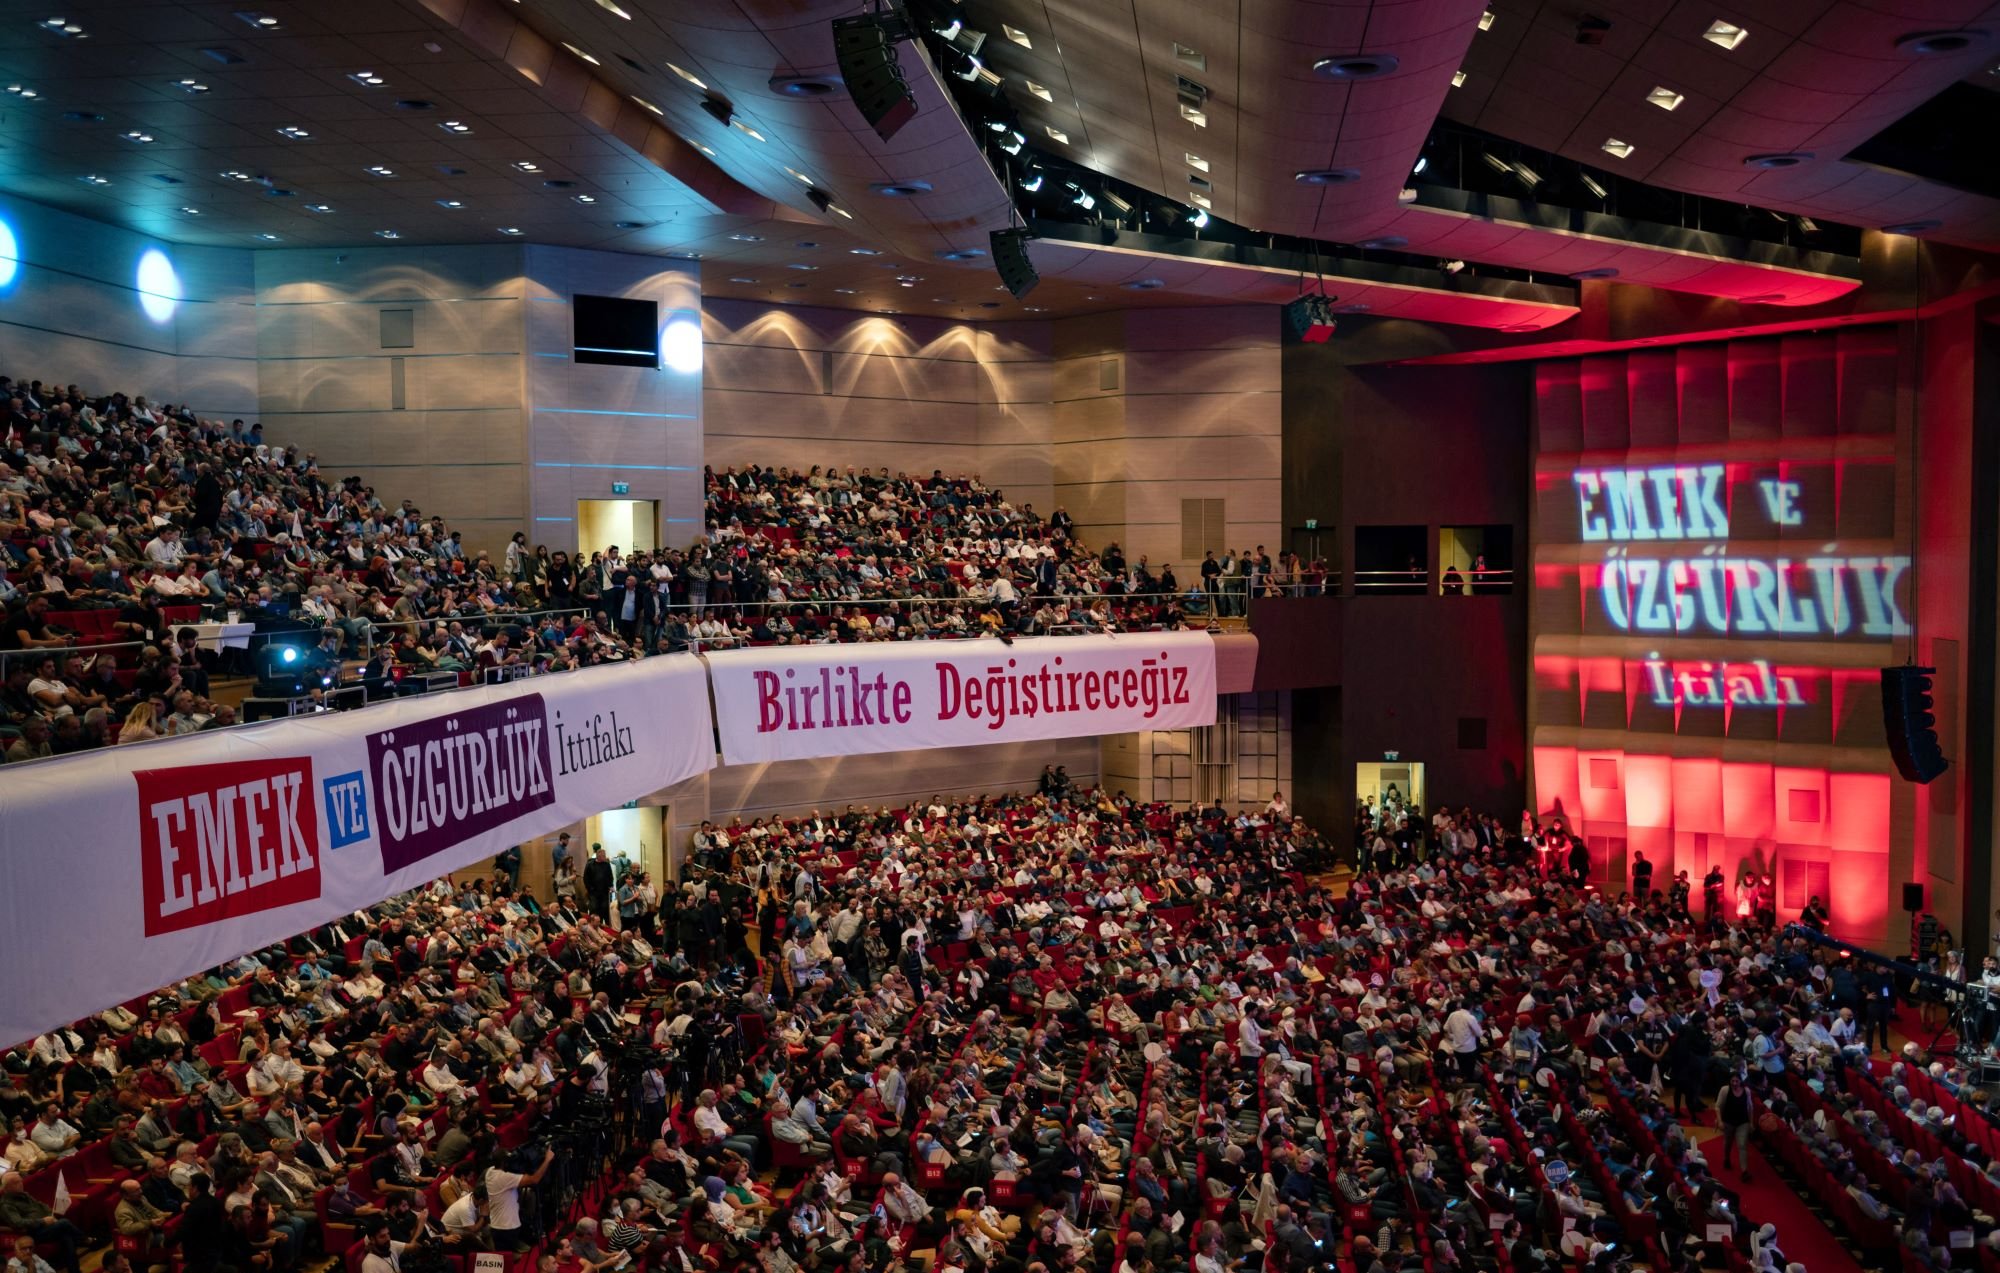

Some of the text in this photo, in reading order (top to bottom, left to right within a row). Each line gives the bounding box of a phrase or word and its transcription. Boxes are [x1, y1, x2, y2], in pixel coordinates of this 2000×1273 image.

[1574, 465, 1802, 541] EMEK VE
[753, 651, 1190, 733] Birlikte Değiştireceğiz
[151, 708, 635, 917] EMEK VE ÖZGÜRLÜK İttifakı
[476, 1260, 503, 1268] BASIN
